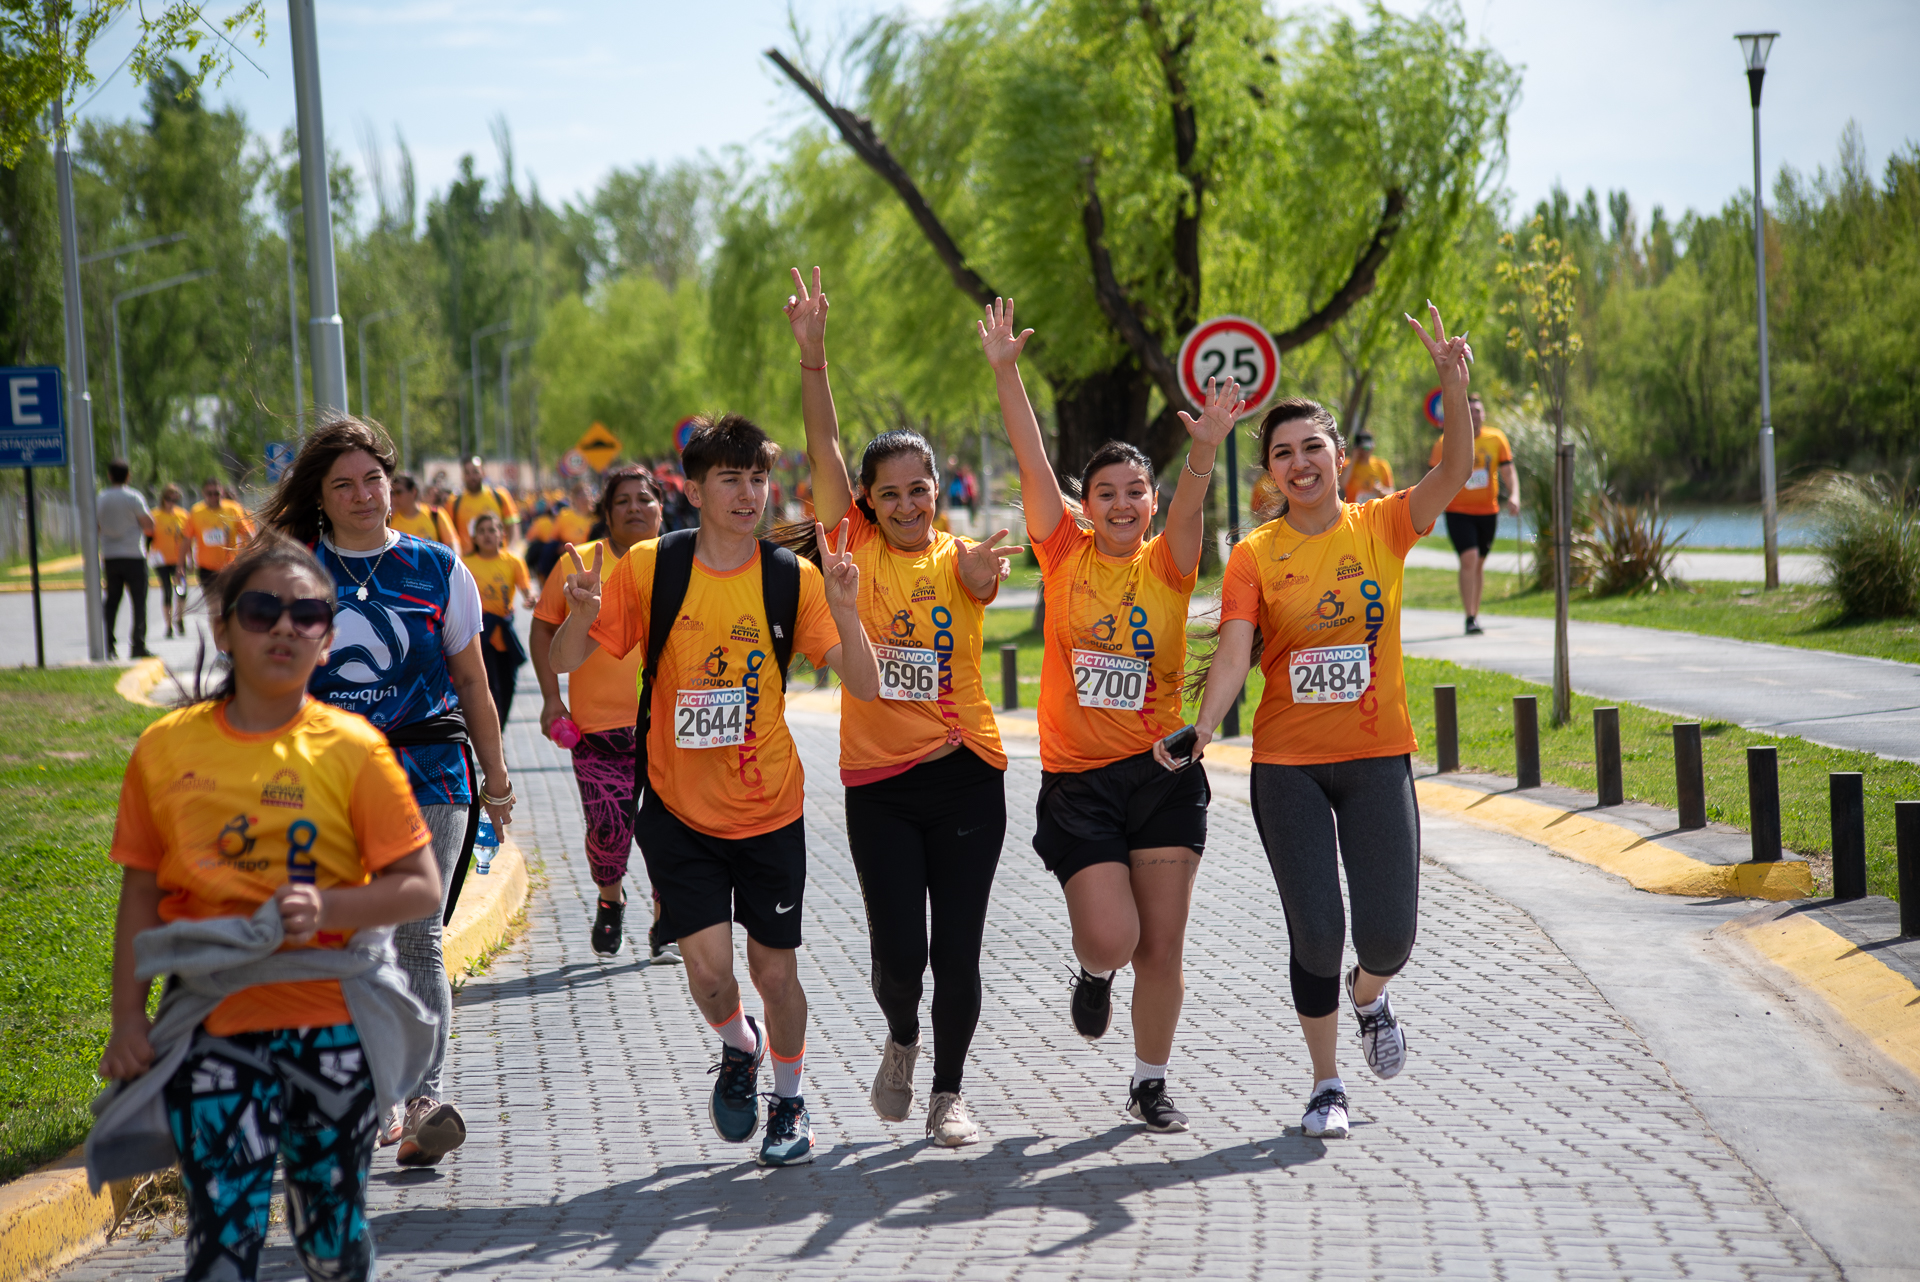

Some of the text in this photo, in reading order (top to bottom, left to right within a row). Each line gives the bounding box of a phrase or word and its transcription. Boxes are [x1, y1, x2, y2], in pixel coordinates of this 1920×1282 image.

[1202, 347, 1257, 387] 25
[9, 376, 42, 425] E
[0, 438, 60, 451] STACIONAR
[1337, 565, 1363, 577] ACTIVA
[911, 589, 936, 598] ACTIVA
[731, 628, 759, 639] ACTIVA
[773, 625, 784, 639] NIKE
[1075, 654, 1143, 670] ACTIVANDO
[1294, 649, 1363, 664] ACTIVANDO
[1074, 666, 1142, 700] 2700
[1294, 662, 1365, 694] 2484
[680, 692, 742, 706] ACTIVANDO
[678, 705, 742, 737] 2644
[261, 790, 304, 803] ACTIVA
